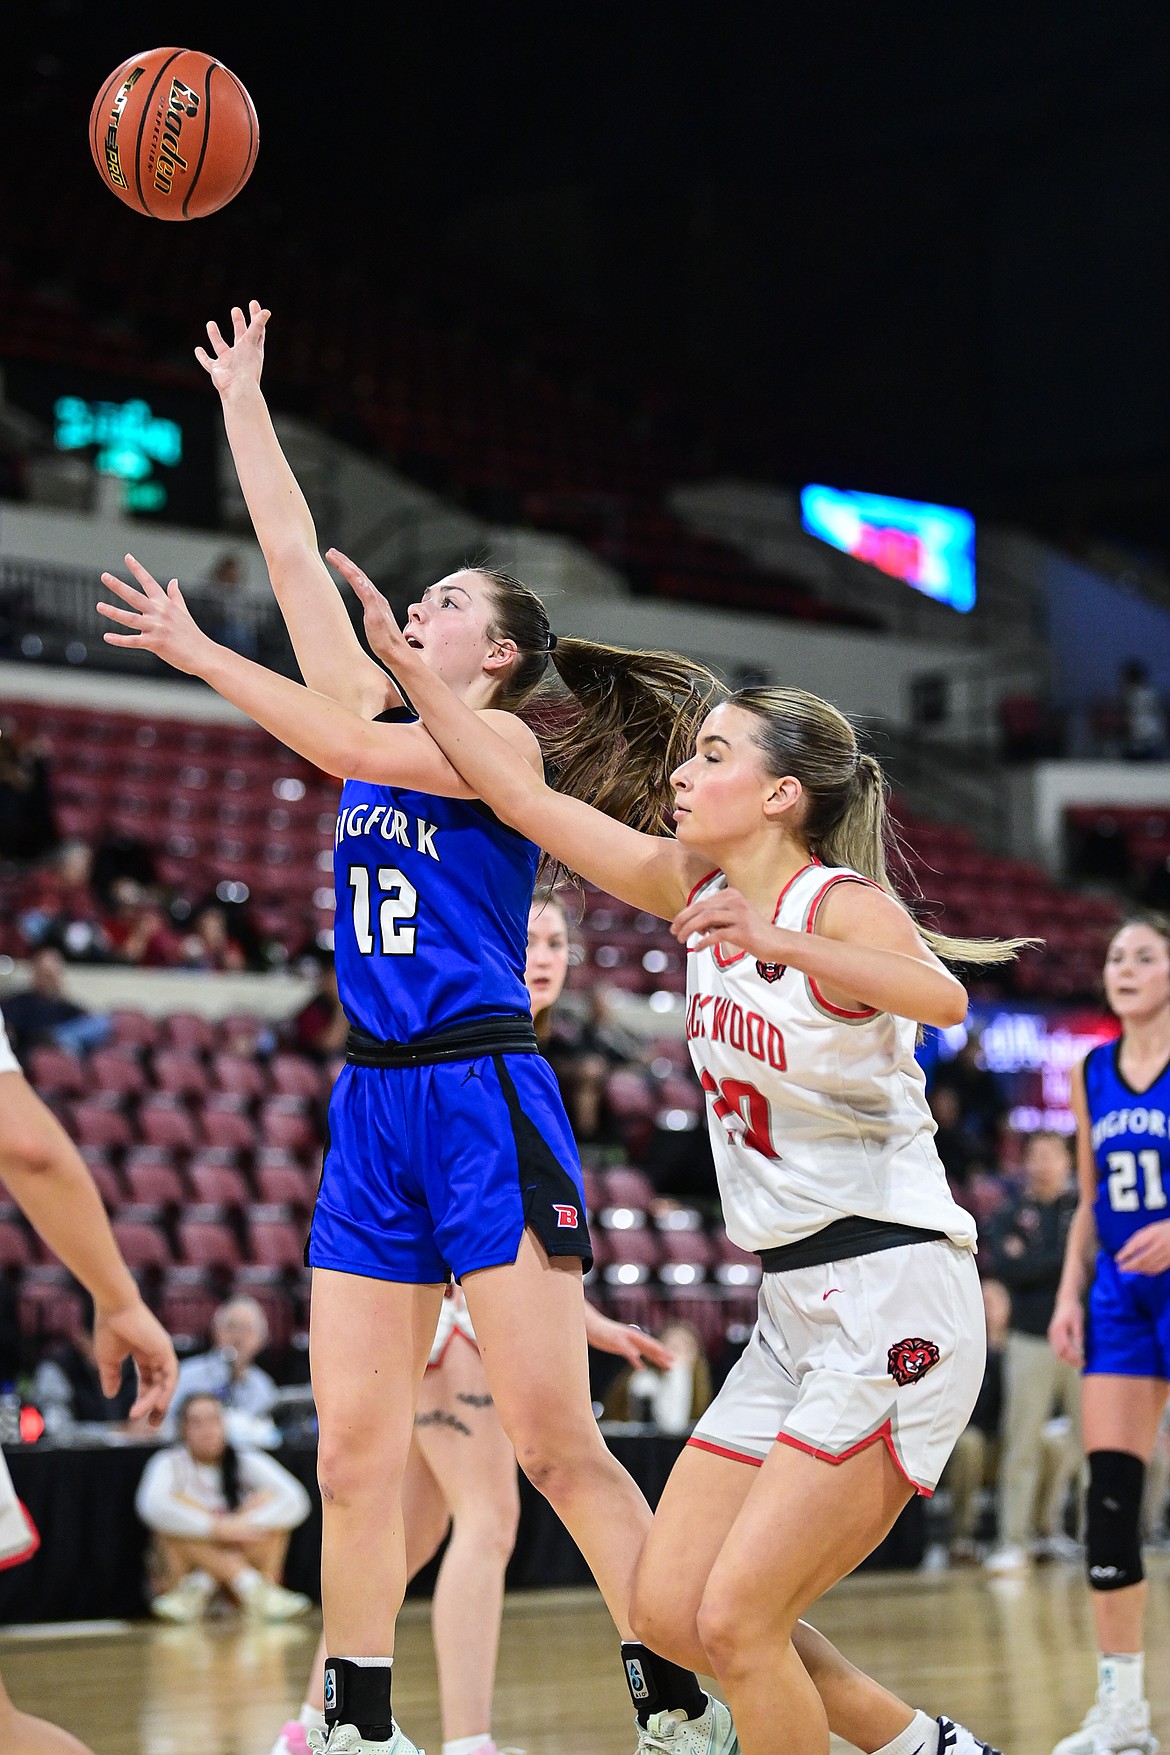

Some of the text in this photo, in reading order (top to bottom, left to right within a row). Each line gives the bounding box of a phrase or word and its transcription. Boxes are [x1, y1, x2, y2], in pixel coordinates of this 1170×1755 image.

[154, 77, 200, 195] Baden
[105, 147, 128, 189] PRO
[335, 804, 440, 862] IGFORK
[349, 866, 417, 954] 12
[1107, 1149, 1167, 1212] 21
[552, 1204, 578, 1228] B
